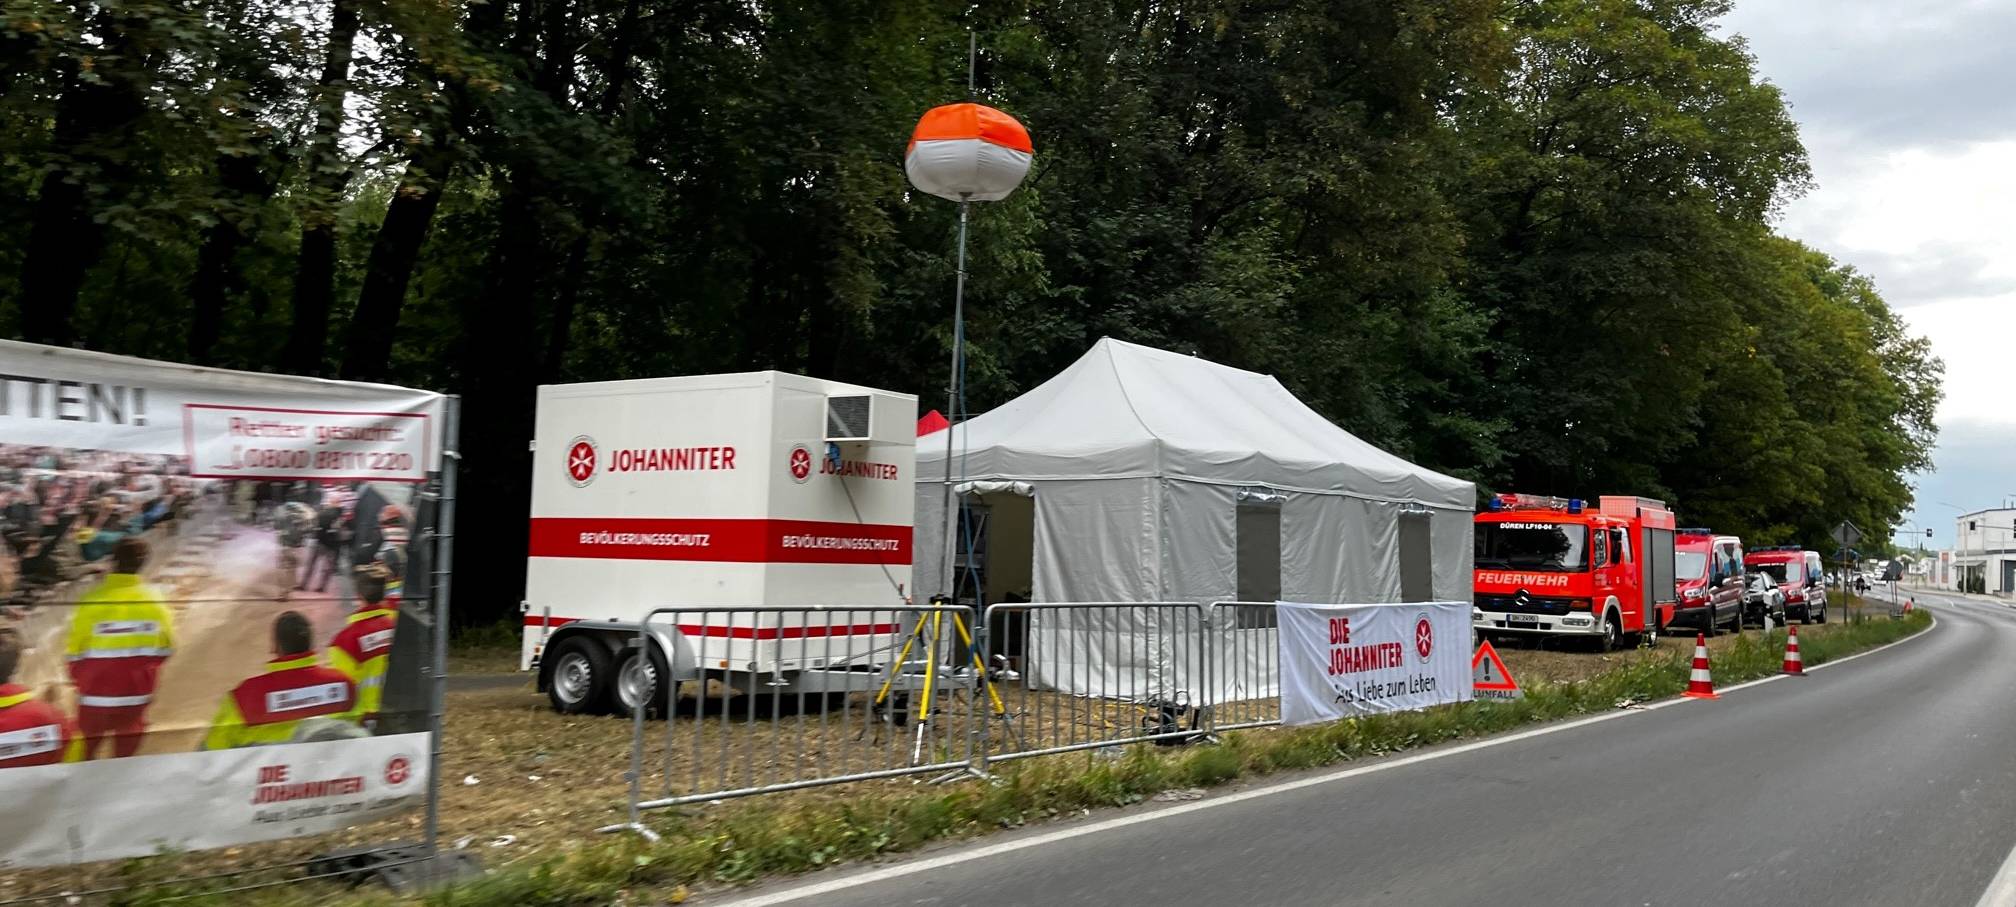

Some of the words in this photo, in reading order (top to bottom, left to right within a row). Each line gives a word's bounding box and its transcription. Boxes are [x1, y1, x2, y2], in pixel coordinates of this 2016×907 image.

[230, 417, 306, 438] Retter
[245, 448, 310, 469] 0800
[608, 447, 735, 472] JOHANNITER
[579, 531, 710, 546] BEVÖLKERUNGSSCHUTZ
[782, 534, 899, 551] BEVÖLKERUNGSSCHUTZ
[1477, 572, 1569, 587] FEUERWEHR
[1329, 617, 1350, 645] DIE
[1328, 642, 1403, 676] JOHANNITER
[1356, 679, 1384, 702] Liebe
[1386, 680, 1407, 698] zum
[1409, 673, 1436, 695] Leben
[1473, 689, 1516, 699] LUNFALL
[259, 765, 290, 784] DIE
[252, 776, 364, 804] JOHANNITER
